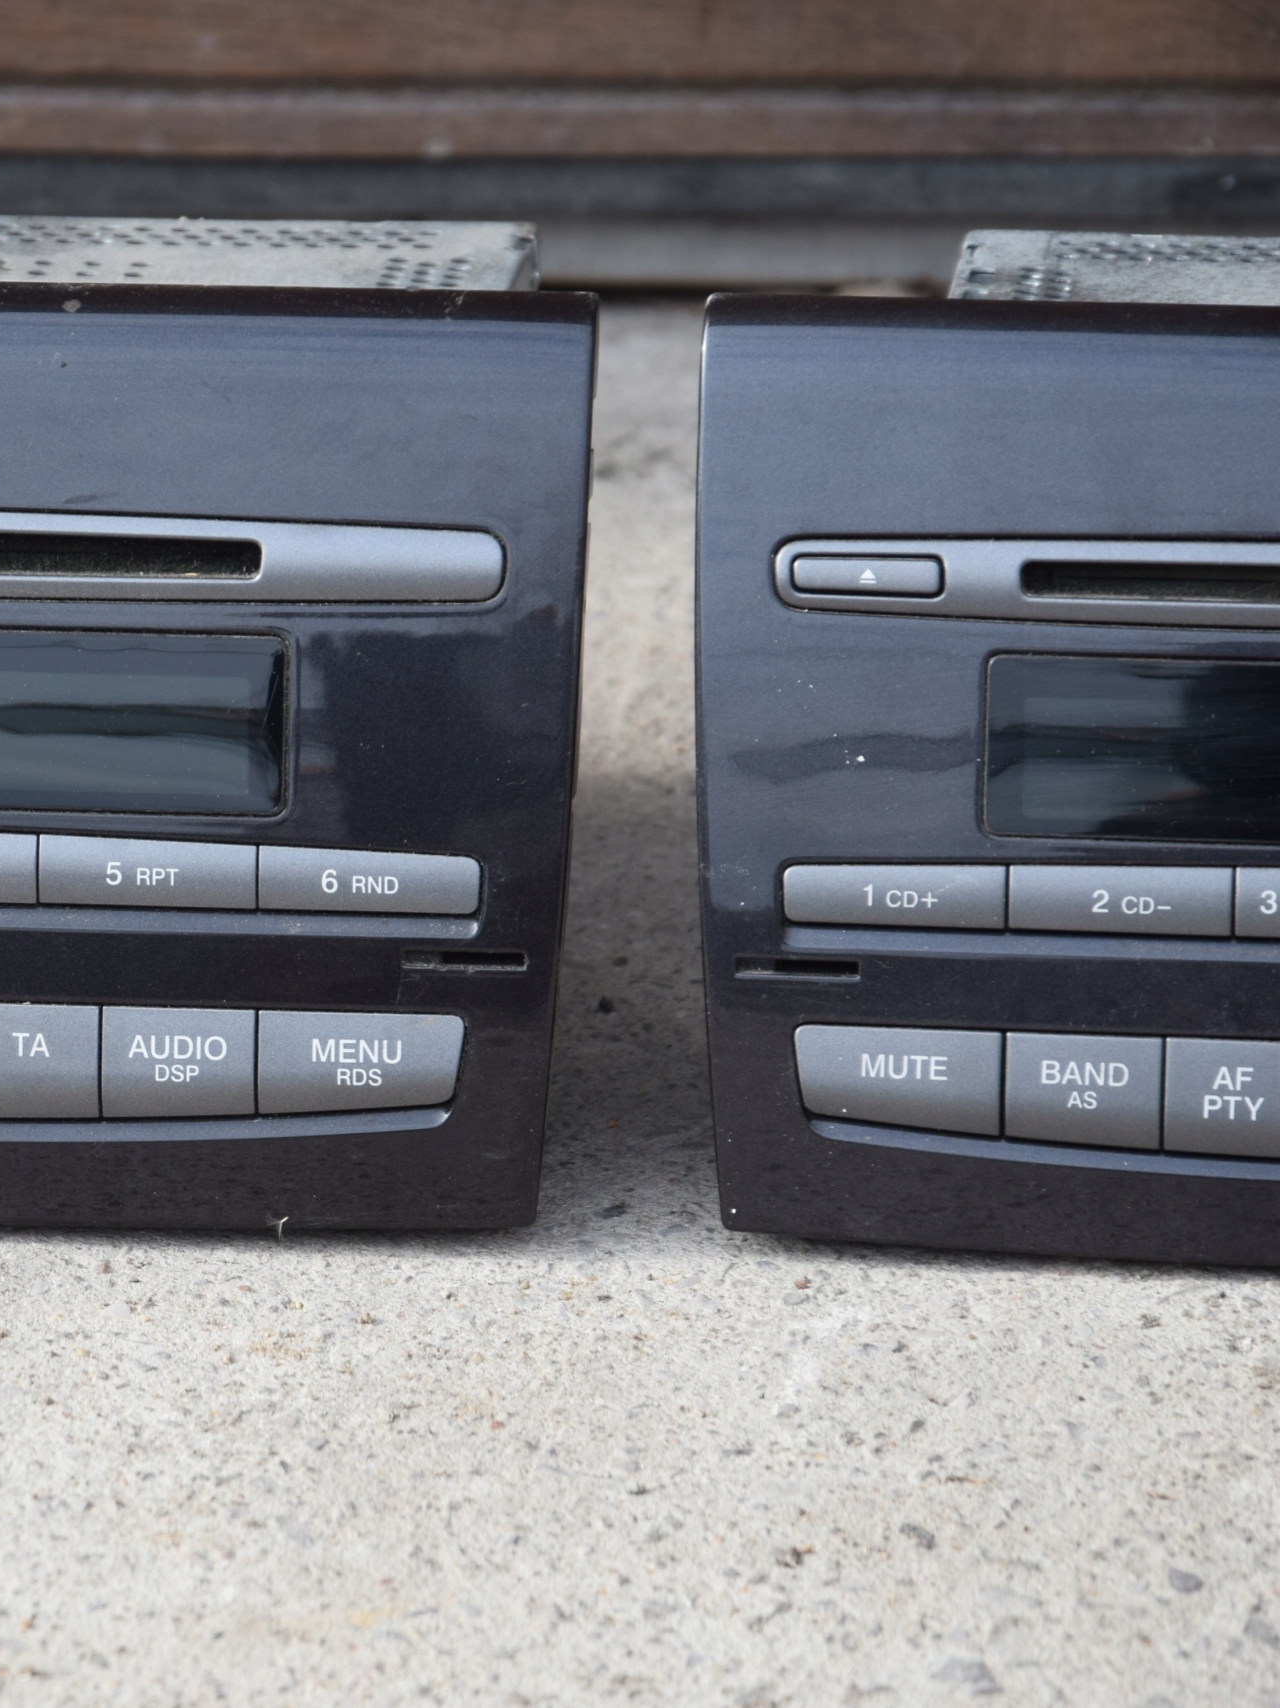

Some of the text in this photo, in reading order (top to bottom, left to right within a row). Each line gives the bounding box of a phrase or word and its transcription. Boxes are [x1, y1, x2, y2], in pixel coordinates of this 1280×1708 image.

[105, 861, 180, 887] 5 RPT
[321, 868, 399, 895] 6 RND
[863, 883, 939, 909] 1 CD+
[1091, 889, 1109, 914] 2
[1259, 889, 1278, 915] 3
[11, 1032, 50, 1058] TA
[127, 1034, 228, 1061] AUDIO
[311, 1038, 402, 1065] MENU
[154, 1064, 200, 1083] DSP
[336, 1068, 383, 1087] RDS
[860, 1053, 949, 1081] MUTE
[1040, 1059, 1130, 1088] BAND
[1212, 1065, 1255, 1091] AF
[1066, 1090, 1098, 1110] AS
[1202, 1094, 1265, 1122] PTY
